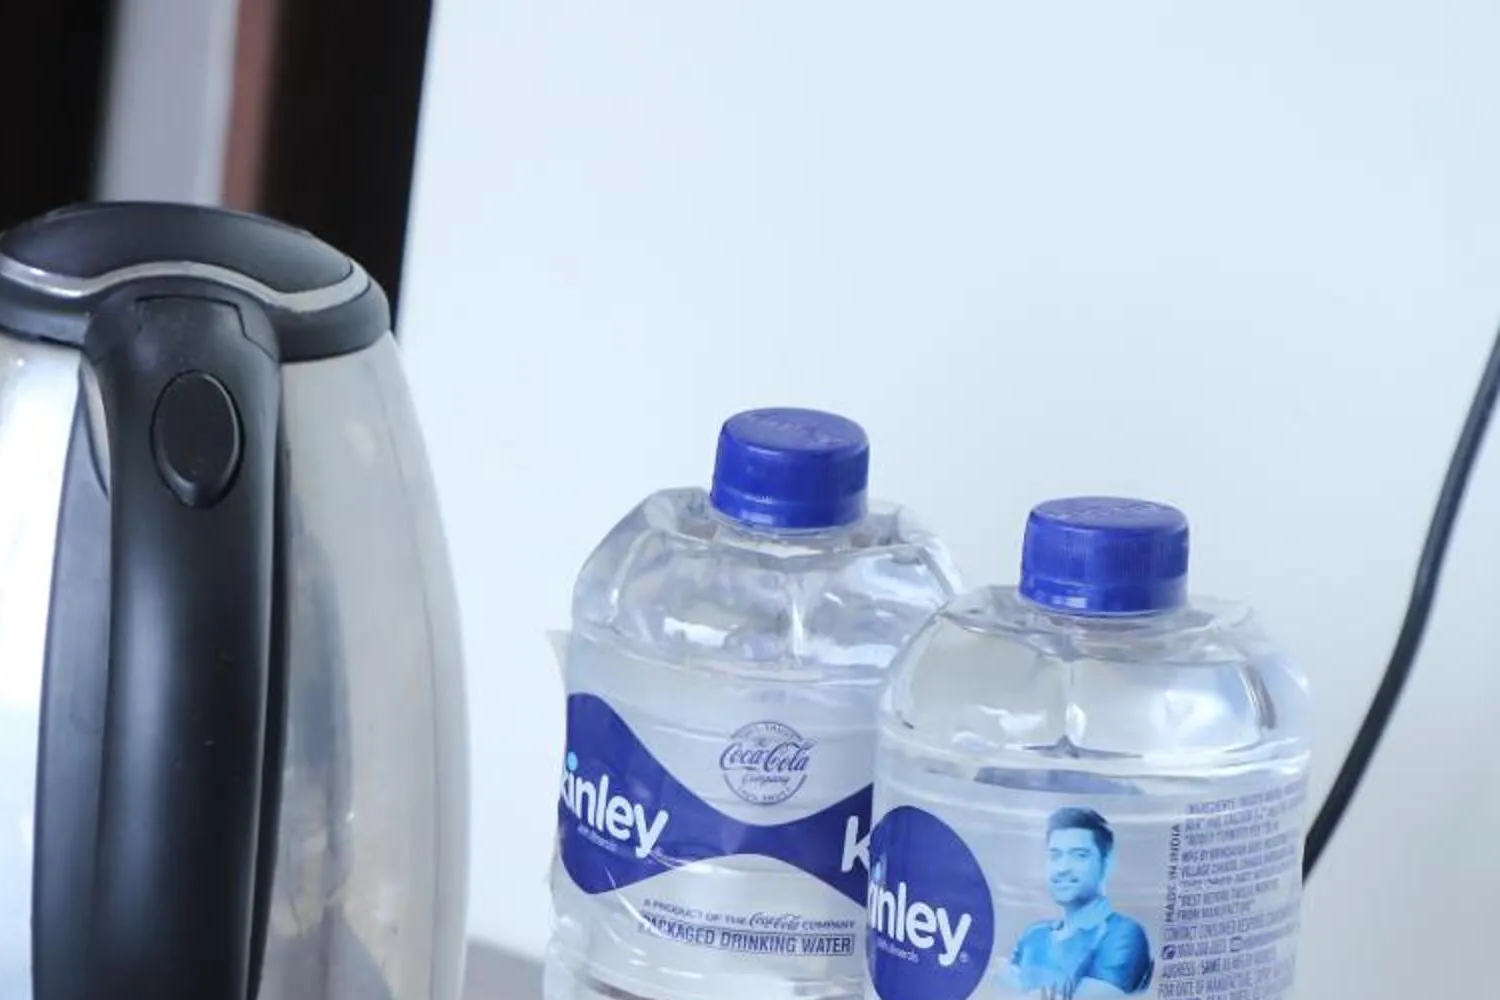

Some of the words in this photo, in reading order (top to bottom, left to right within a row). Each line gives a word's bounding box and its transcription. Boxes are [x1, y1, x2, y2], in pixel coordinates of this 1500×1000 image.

[562, 751, 669, 858] inley
[719, 930, 796, 953] DRINKING
[802, 936, 851, 953] WATER
[868, 860, 972, 966] inley
